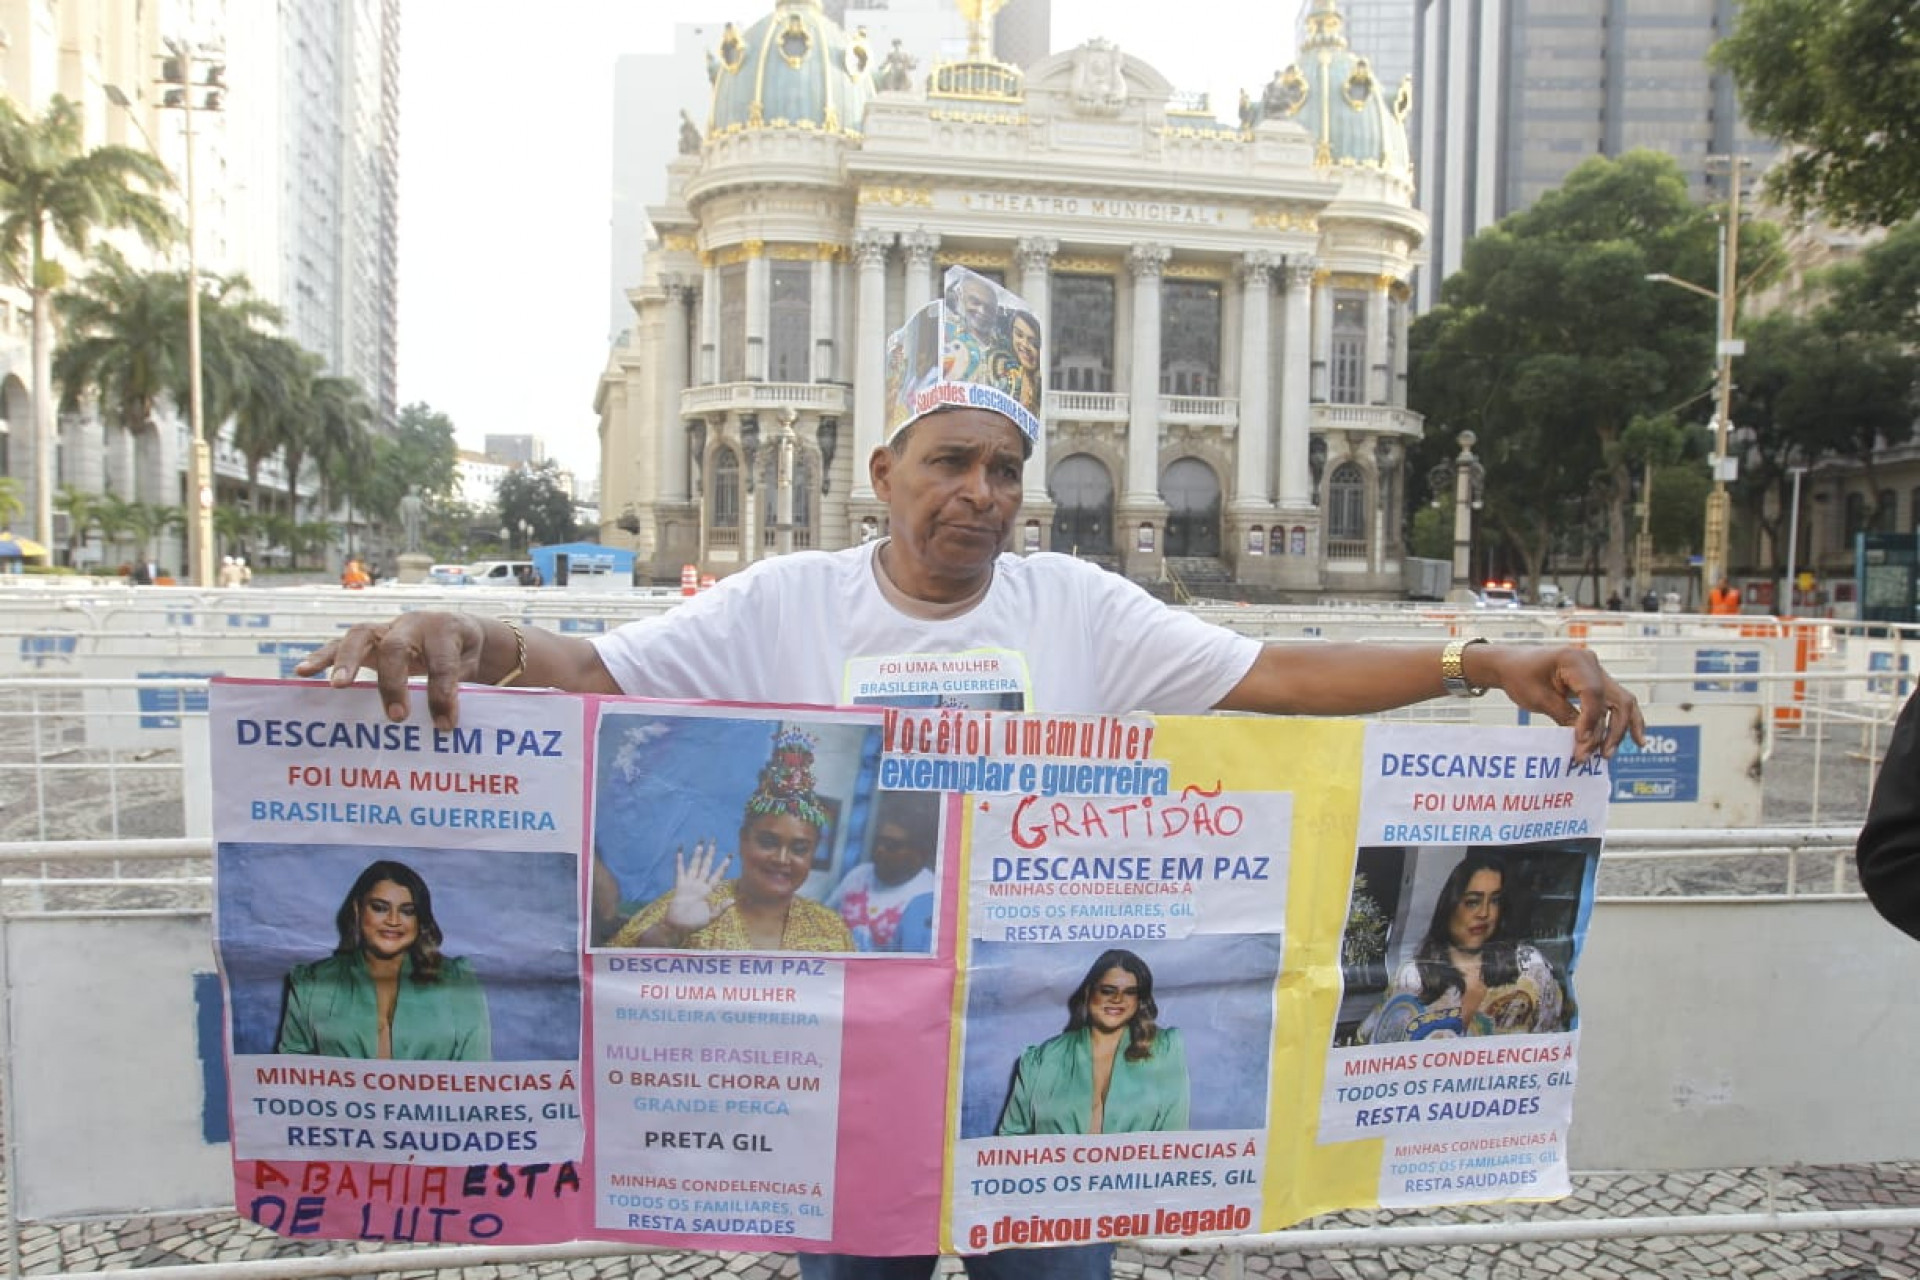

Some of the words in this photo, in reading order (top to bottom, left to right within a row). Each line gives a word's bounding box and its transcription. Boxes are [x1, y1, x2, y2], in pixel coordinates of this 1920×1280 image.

[979, 194, 1078, 214] THEATRO
[1092, 200, 1209, 223] MUNICIPAL
[879, 663, 901, 675] FOI
[906, 661, 938, 673] UMA
[942, 659, 1000, 672] MULHER
[860, 680, 939, 694] BRASILEIRA
[942, 678, 1018, 691] GUERREIRA
[237, 719, 420, 751] DESCANSE
[434, 728, 481, 754] EM
[496, 728, 562, 756] PAZ
[1642, 735, 1677, 754] Rio
[881, 756, 1016, 793] exemplar
[1019, 763, 1036, 792] e
[1041, 761, 1168, 796] guerreira
[1381, 752, 1515, 779] DESCANSE
[1525, 756, 1560, 779] EM
[288, 766, 331, 787] FOI
[340, 768, 400, 790] UMA
[410, 771, 519, 794] MULHER
[1413, 793, 1445, 811] FOI
[1452, 794, 1496, 811] UMA
[1503, 791, 1574, 812] MULHER
[251, 801, 401, 825] BRASILEIRA
[410, 807, 556, 831] GUERREIRA
[1383, 823, 1493, 842] BRASILEIRA
[1499, 819, 1588, 841] GUERREIRA
[992, 857, 1149, 882] DESCANSE
[1161, 858, 1203, 880] EM
[1213, 857, 1270, 880] PAZ
[989, 883, 1054, 897] MINHAS
[1059, 882, 1177, 895] CONDELENCIAS
[986, 905, 1040, 919] TODOS
[1045, 904, 1065, 918] OS
[1071, 903, 1164, 918] FAMILIARES,
[1170, 903, 1193, 916] GIL
[1006, 926, 1062, 941] RESTA
[1068, 924, 1166, 940] SAUDADES
[609, 957, 732, 975] DESCANSE
[739, 959, 773, 975] EM
[781, 959, 826, 976] PAZ
[640, 984, 669, 999] FOI
[675, 985, 717, 1000] UMA
[722, 987, 797, 1002] MULHER
[615, 1007, 716, 1023] BRASILEIRA
[721, 1010, 820, 1026] GUERREIRA
[606, 1045, 694, 1062] MULHER
[700, 1048, 823, 1068] BRASILEIRA,
[1344, 1054, 1417, 1076] MINHAS
[1423, 1046, 1560, 1068] CONDELENCIAS
[1563, 1041, 1572, 1060] Á
[256, 1068, 356, 1088] MINHAS
[363, 1072, 551, 1092] CONDELENCIAS
[559, 1070, 575, 1090] Á
[609, 1070, 623, 1085] O
[631, 1072, 701, 1088] BRASIL
[708, 1074, 780, 1090] CHORA
[787, 1076, 820, 1091] UM
[1336, 1081, 1398, 1103] TODOS
[1403, 1079, 1427, 1096] OS
[1432, 1073, 1541, 1094] FAMILIARES,
[1547, 1071, 1573, 1087] GIL
[253, 1098, 338, 1117] TODOS
[345, 1102, 376, 1120] OS
[384, 1104, 533, 1123] FAMILIARES,
[542, 1103, 580, 1119] GIL
[633, 1097, 719, 1113] GRANDE
[726, 1099, 790, 1115] PERCA
[1355, 1105, 1421, 1127] RESTA
[1427, 1096, 1540, 1121] SAUDADES
[288, 1126, 375, 1149] RESTA
[383, 1130, 537, 1151] SAUDADES
[645, 1131, 724, 1149] PRETA
[732, 1133, 773, 1152] GIL
[1395, 1142, 1448, 1157] MINHAS
[1451, 1134, 1546, 1153] CONDELENCIAS
[977, 1148, 1066, 1167] MINHAS
[1073, 1142, 1236, 1162] CONDELENCIAS
[1242, 1137, 1257, 1157] Á
[1390, 1161, 1435, 1176] TODOS
[1439, 1160, 1456, 1172] OS
[1539, 1150, 1560, 1164] GIL
[255, 1160, 289, 1190] A
[462, 1160, 580, 1199] ESTA
[611, 1174, 677, 1190] MINHAS
[681, 1179, 806, 1195] CONDELENCIAS
[811, 1183, 822, 1197] Á
[971, 1177, 1046, 1196] TODOS
[1053, 1175, 1082, 1192] OS
[1089, 1170, 1217, 1191] FAMILIARES,
[1224, 1169, 1257, 1185] GIL
[1405, 1177, 1452, 1192] RESTA
[1455, 1170, 1537, 1189] SAUDADES
[607, 1194, 663, 1209] TODOS
[668, 1198, 689, 1211] OS
[694, 1200, 793, 1216] FAMILIARES,
[798, 1204, 824, 1217] GIL
[250, 1194, 327, 1236] DE
[359, 1202, 503, 1242] LUTO
[628, 1213, 686, 1231] RESTA
[692, 1218, 795, 1234] SAUDADES
[970, 1224, 987, 1248] e
[993, 1215, 1091, 1245] deixou
[1097, 1212, 1149, 1238] seu
[1155, 1204, 1251, 1236] legado
